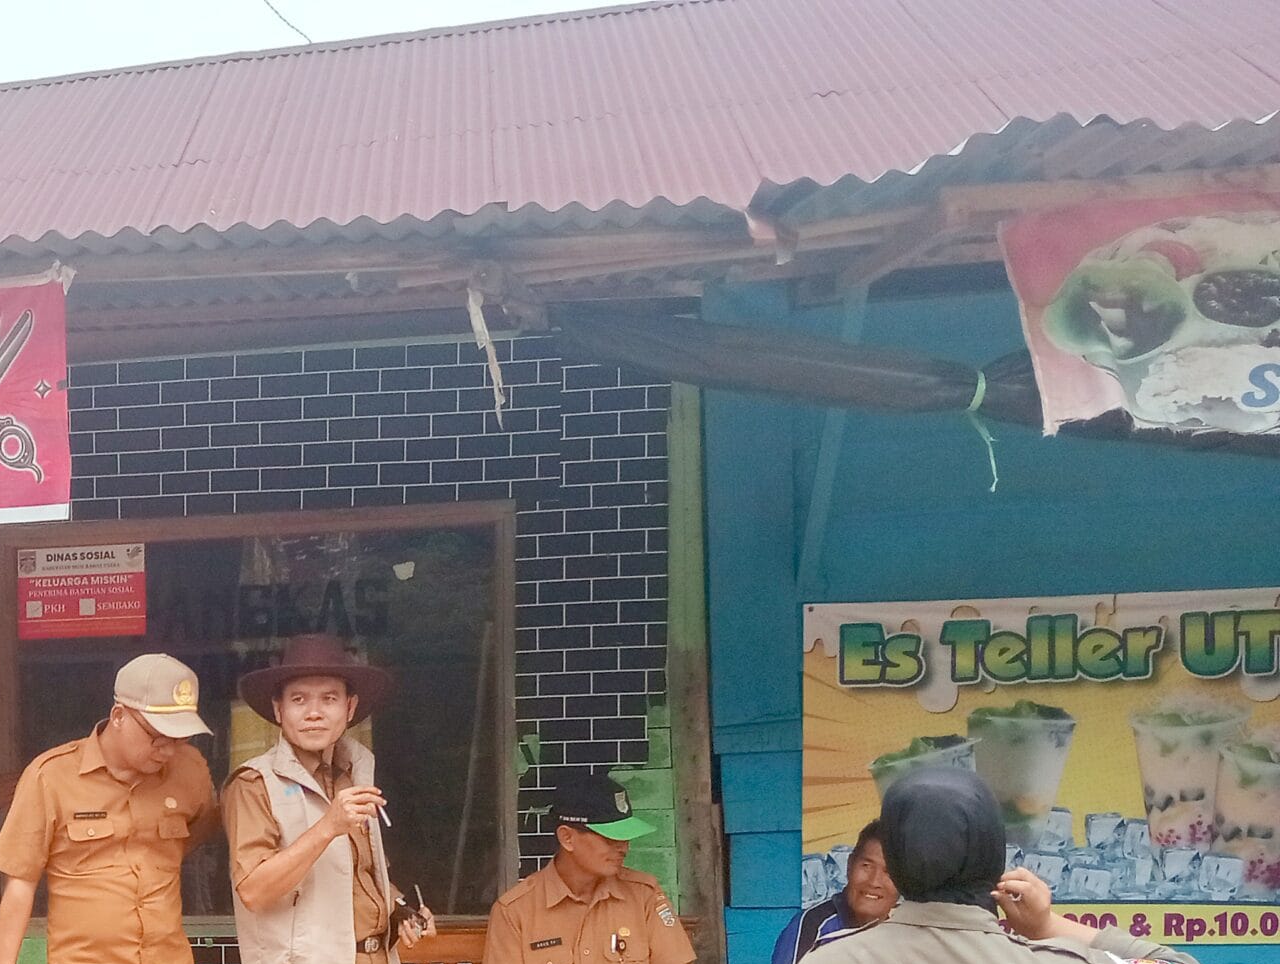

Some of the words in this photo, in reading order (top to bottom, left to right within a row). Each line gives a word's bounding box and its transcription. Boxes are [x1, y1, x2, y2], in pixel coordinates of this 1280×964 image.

[46, 552, 78, 562] DINAS
[80, 551, 116, 561] SOSIAL
[44, 603, 66, 614] PKH
[96, 600, 141, 611] SEMBAKO
[839, 622, 926, 688] Es
[939, 613, 1165, 684] Teller
[1129, 912, 1152, 937] &
